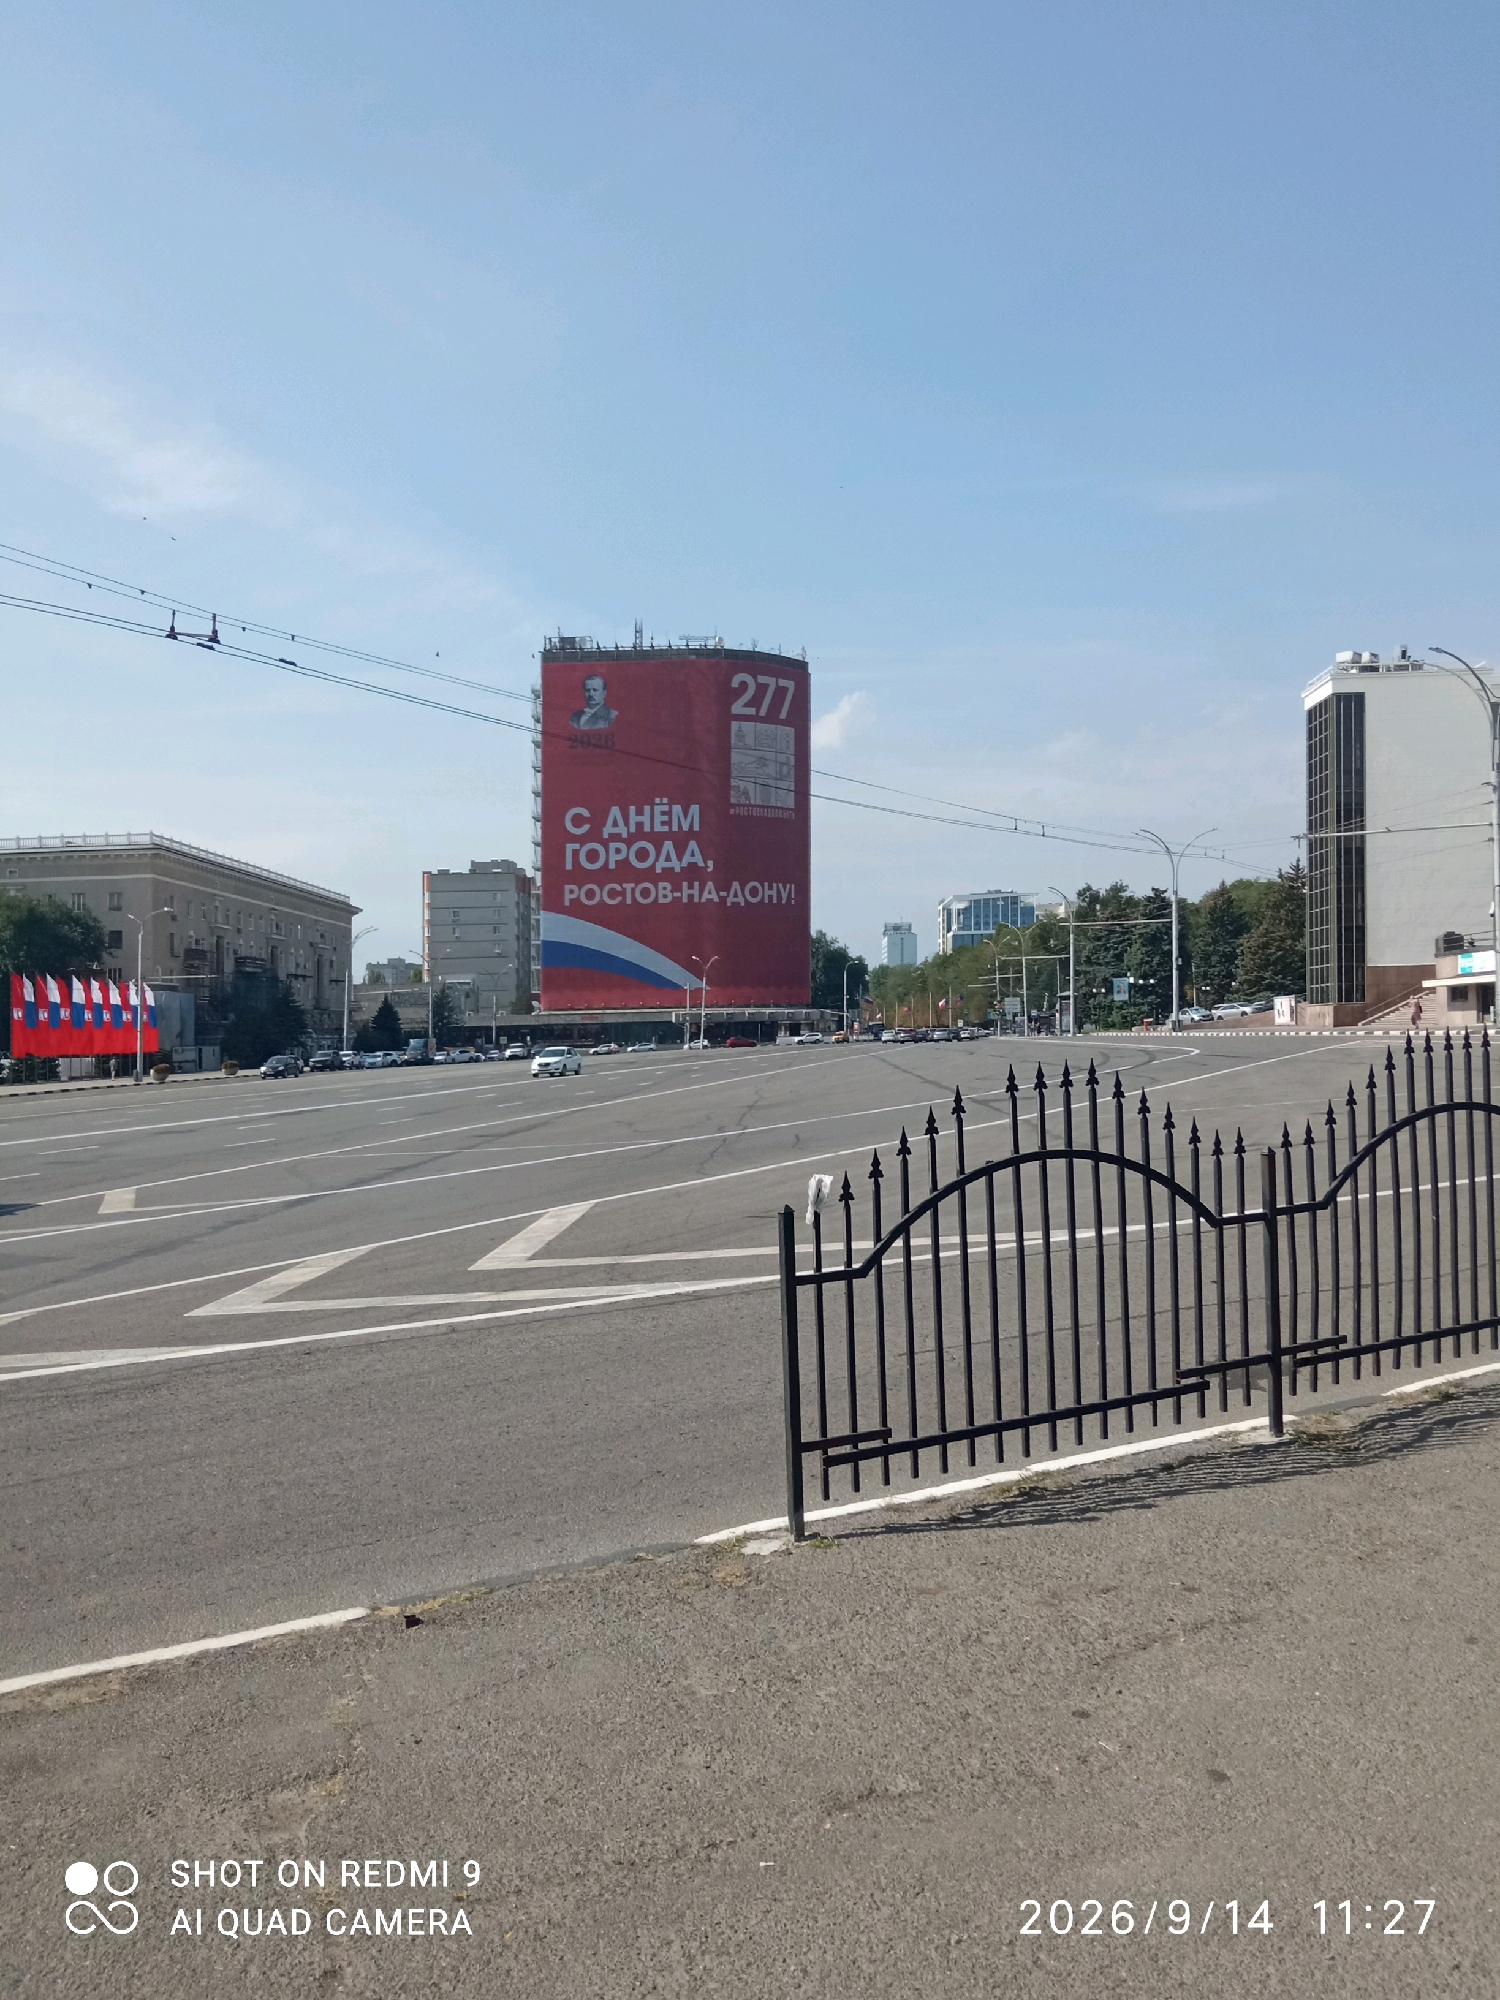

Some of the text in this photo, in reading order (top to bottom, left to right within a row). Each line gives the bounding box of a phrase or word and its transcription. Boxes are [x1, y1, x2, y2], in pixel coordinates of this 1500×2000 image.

[731, 672, 795, 720] 277
[564, 797, 700, 838] С ДНЁМ
[565, 840, 714, 874] ГОРОДА,
[563, 881, 796, 907] РОСТОВ-НА-ДОНУ!
